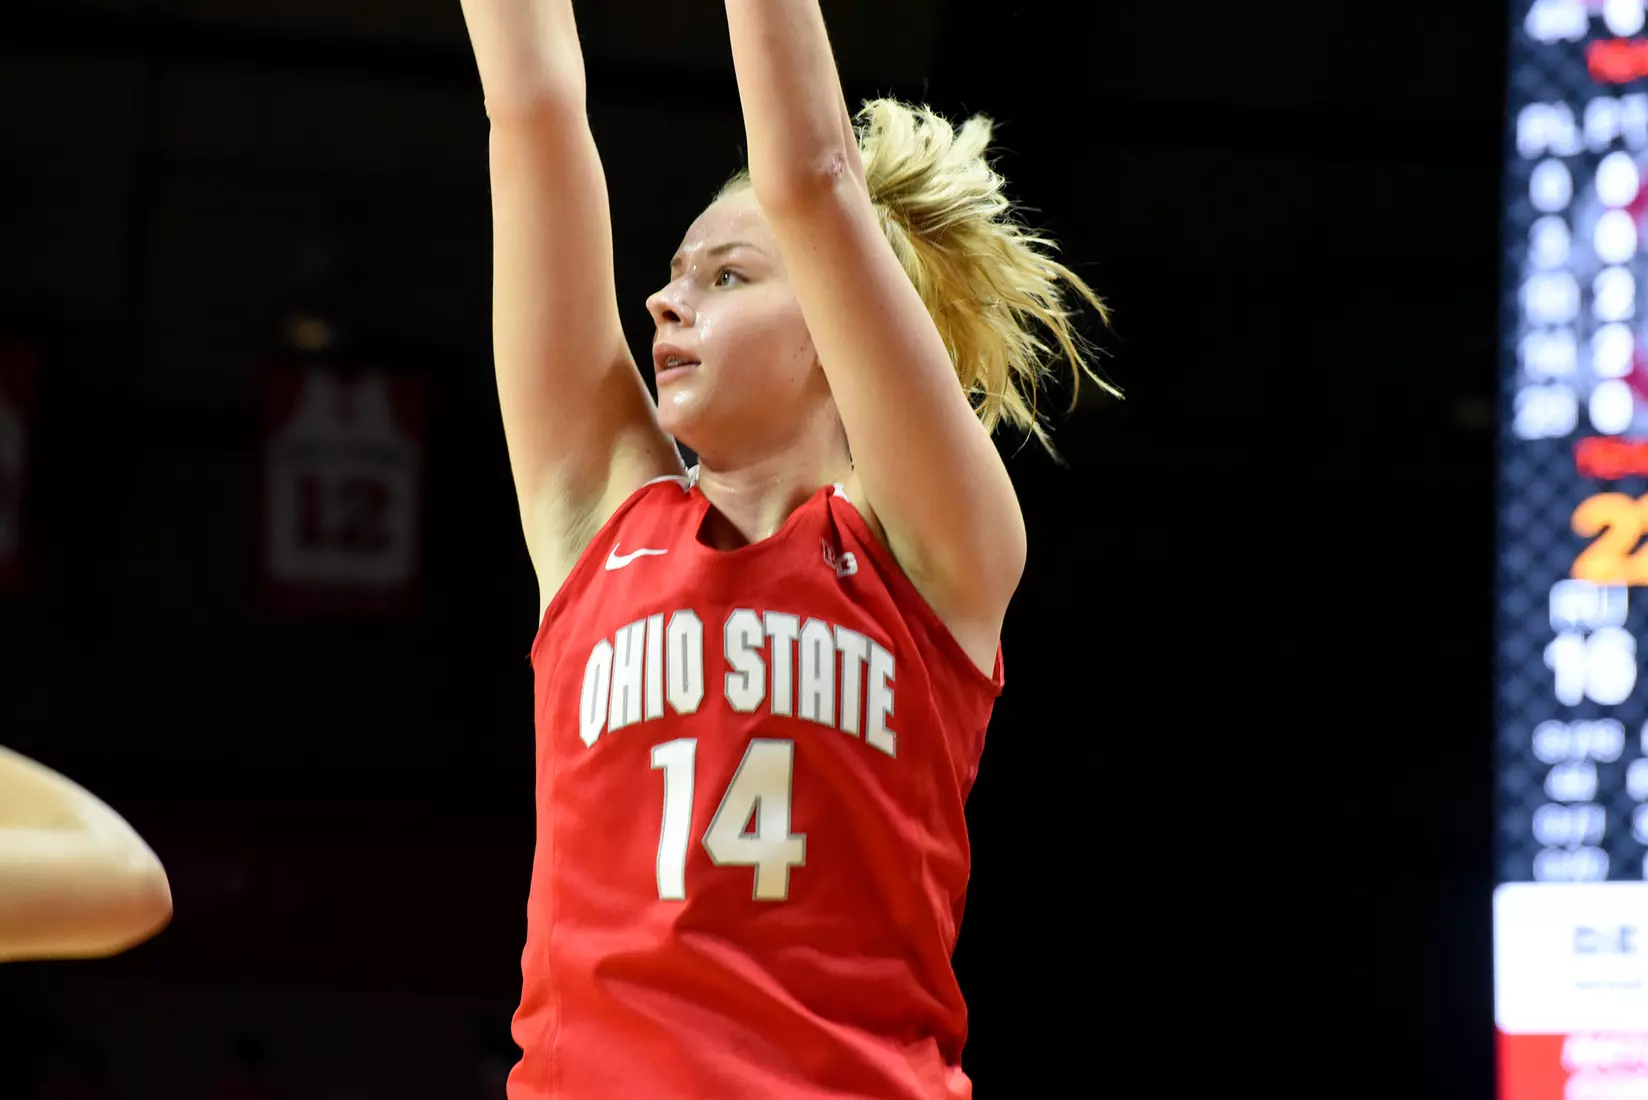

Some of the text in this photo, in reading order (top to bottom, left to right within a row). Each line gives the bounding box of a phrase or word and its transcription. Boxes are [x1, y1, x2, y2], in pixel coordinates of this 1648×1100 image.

[296, 474, 390, 554] 12
[579, 607, 897, 759] OHIO STATE
[650, 737, 806, 901] 14
